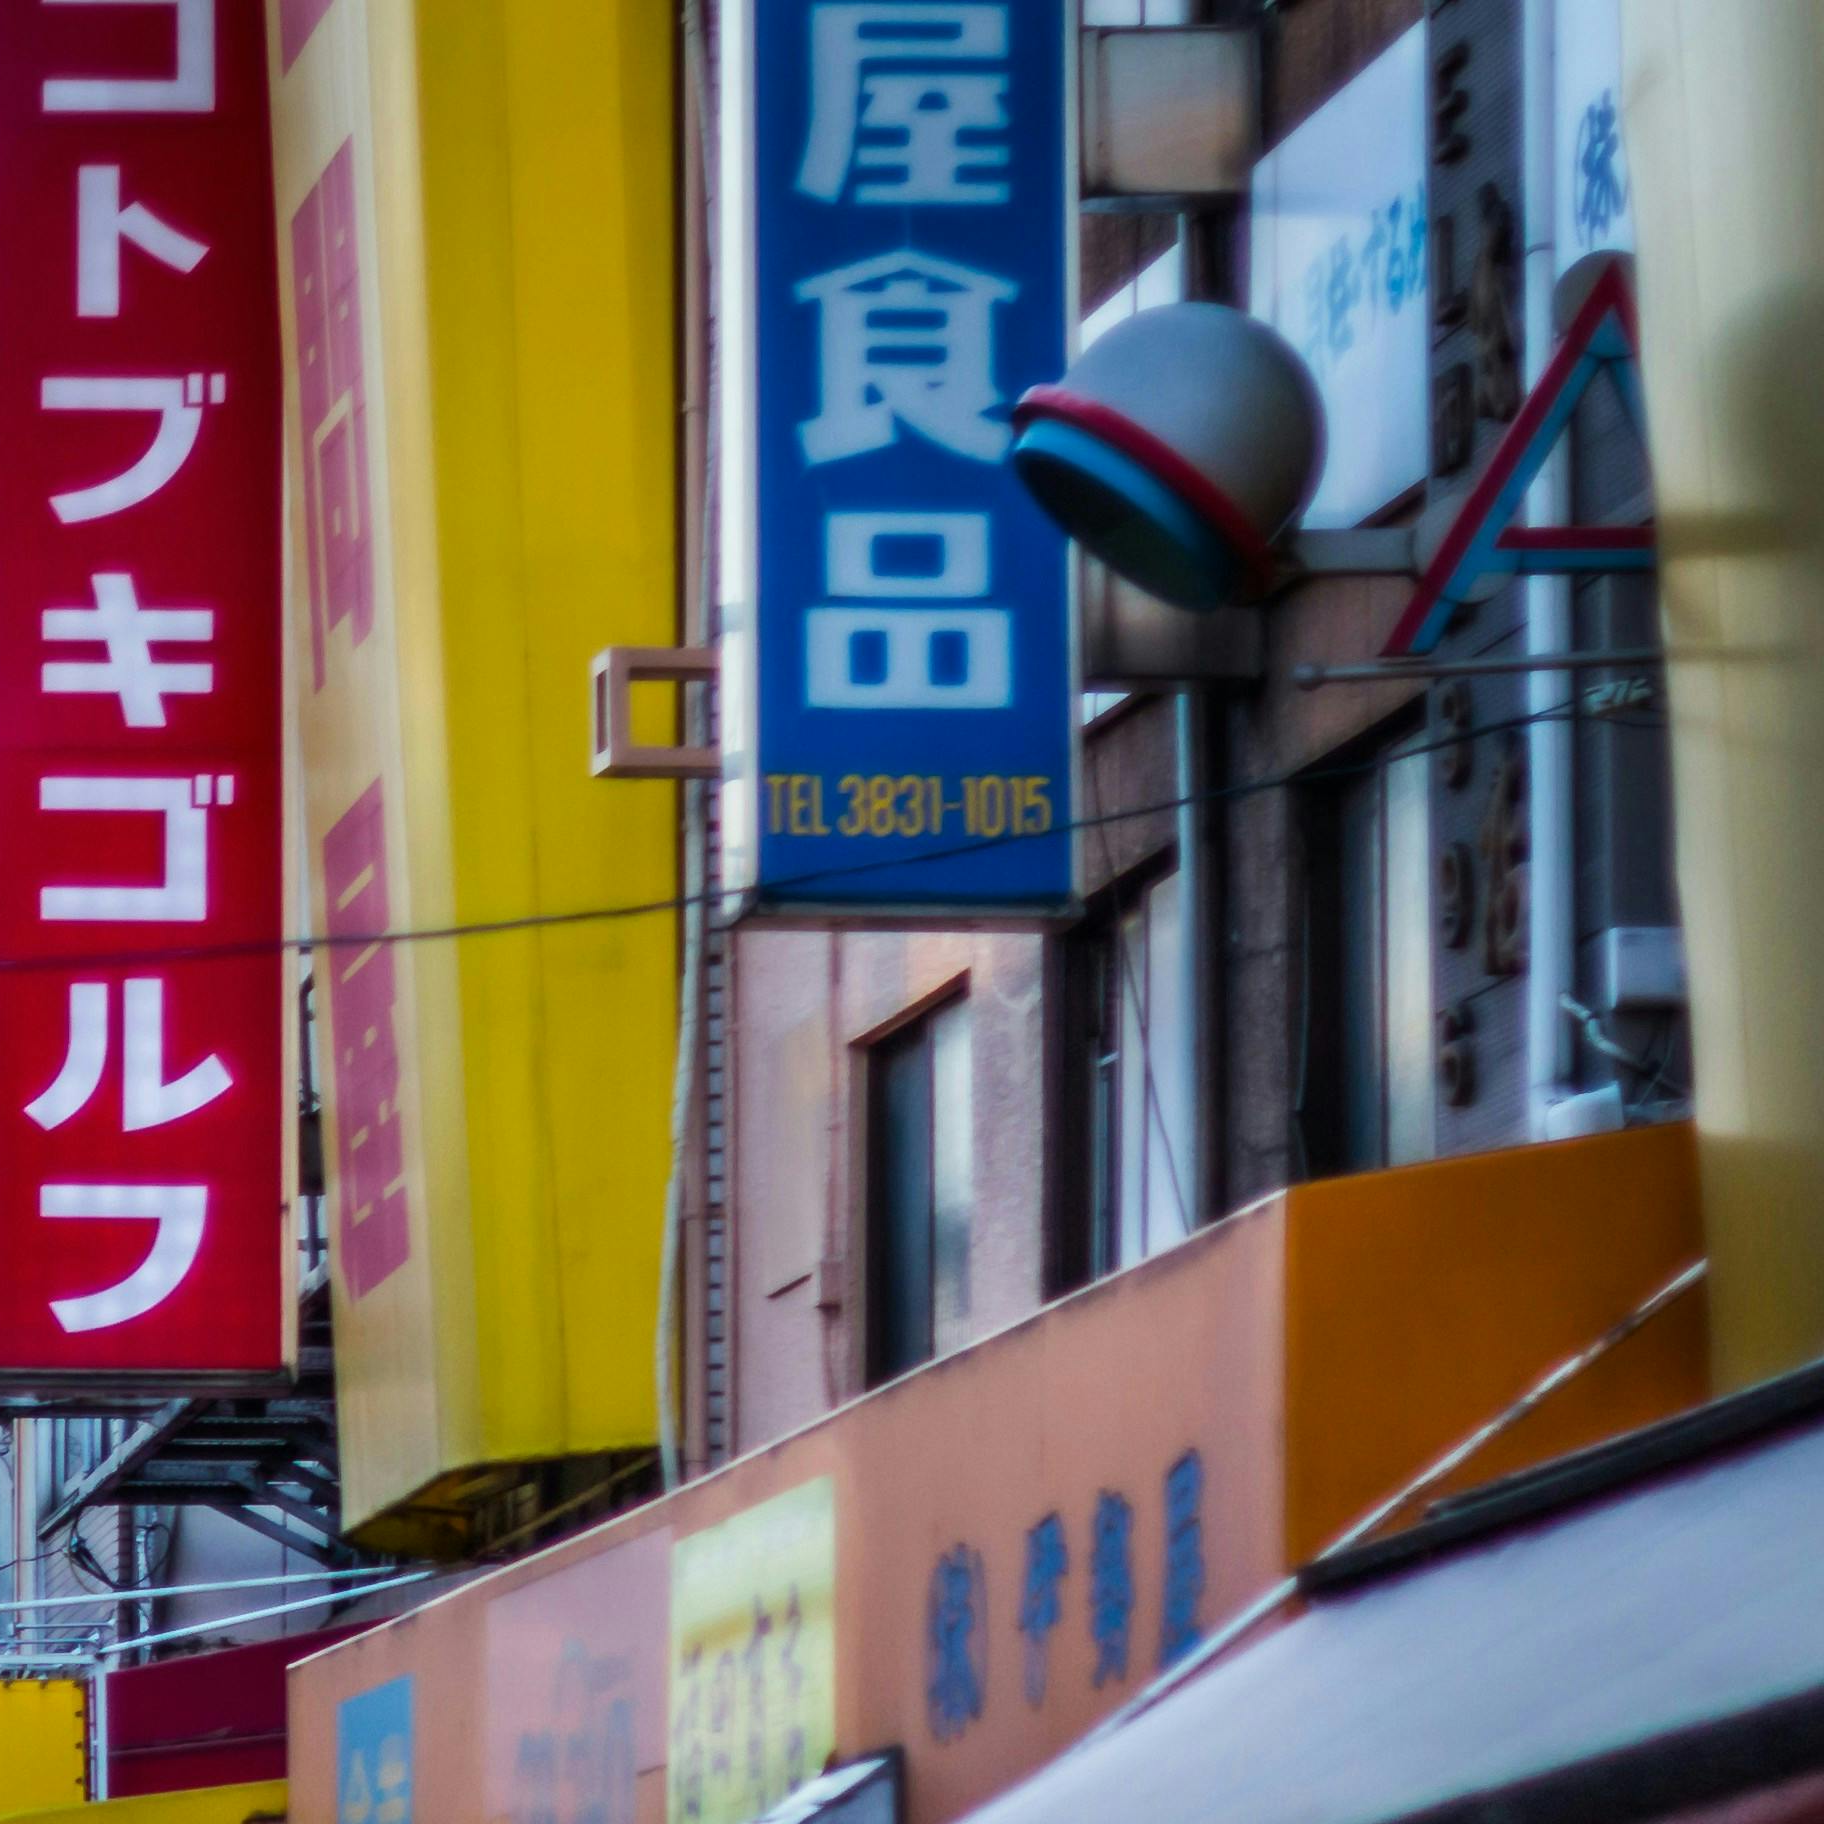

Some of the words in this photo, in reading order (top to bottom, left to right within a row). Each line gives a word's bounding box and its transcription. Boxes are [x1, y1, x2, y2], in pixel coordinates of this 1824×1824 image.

[21, 0, 235, 1334] コトブキゴルフ
[792, 2, 1019, 708] 屋食品
[765, 774, 831, 836] TEL
[837, 774, 1052, 838] 3831-1015
